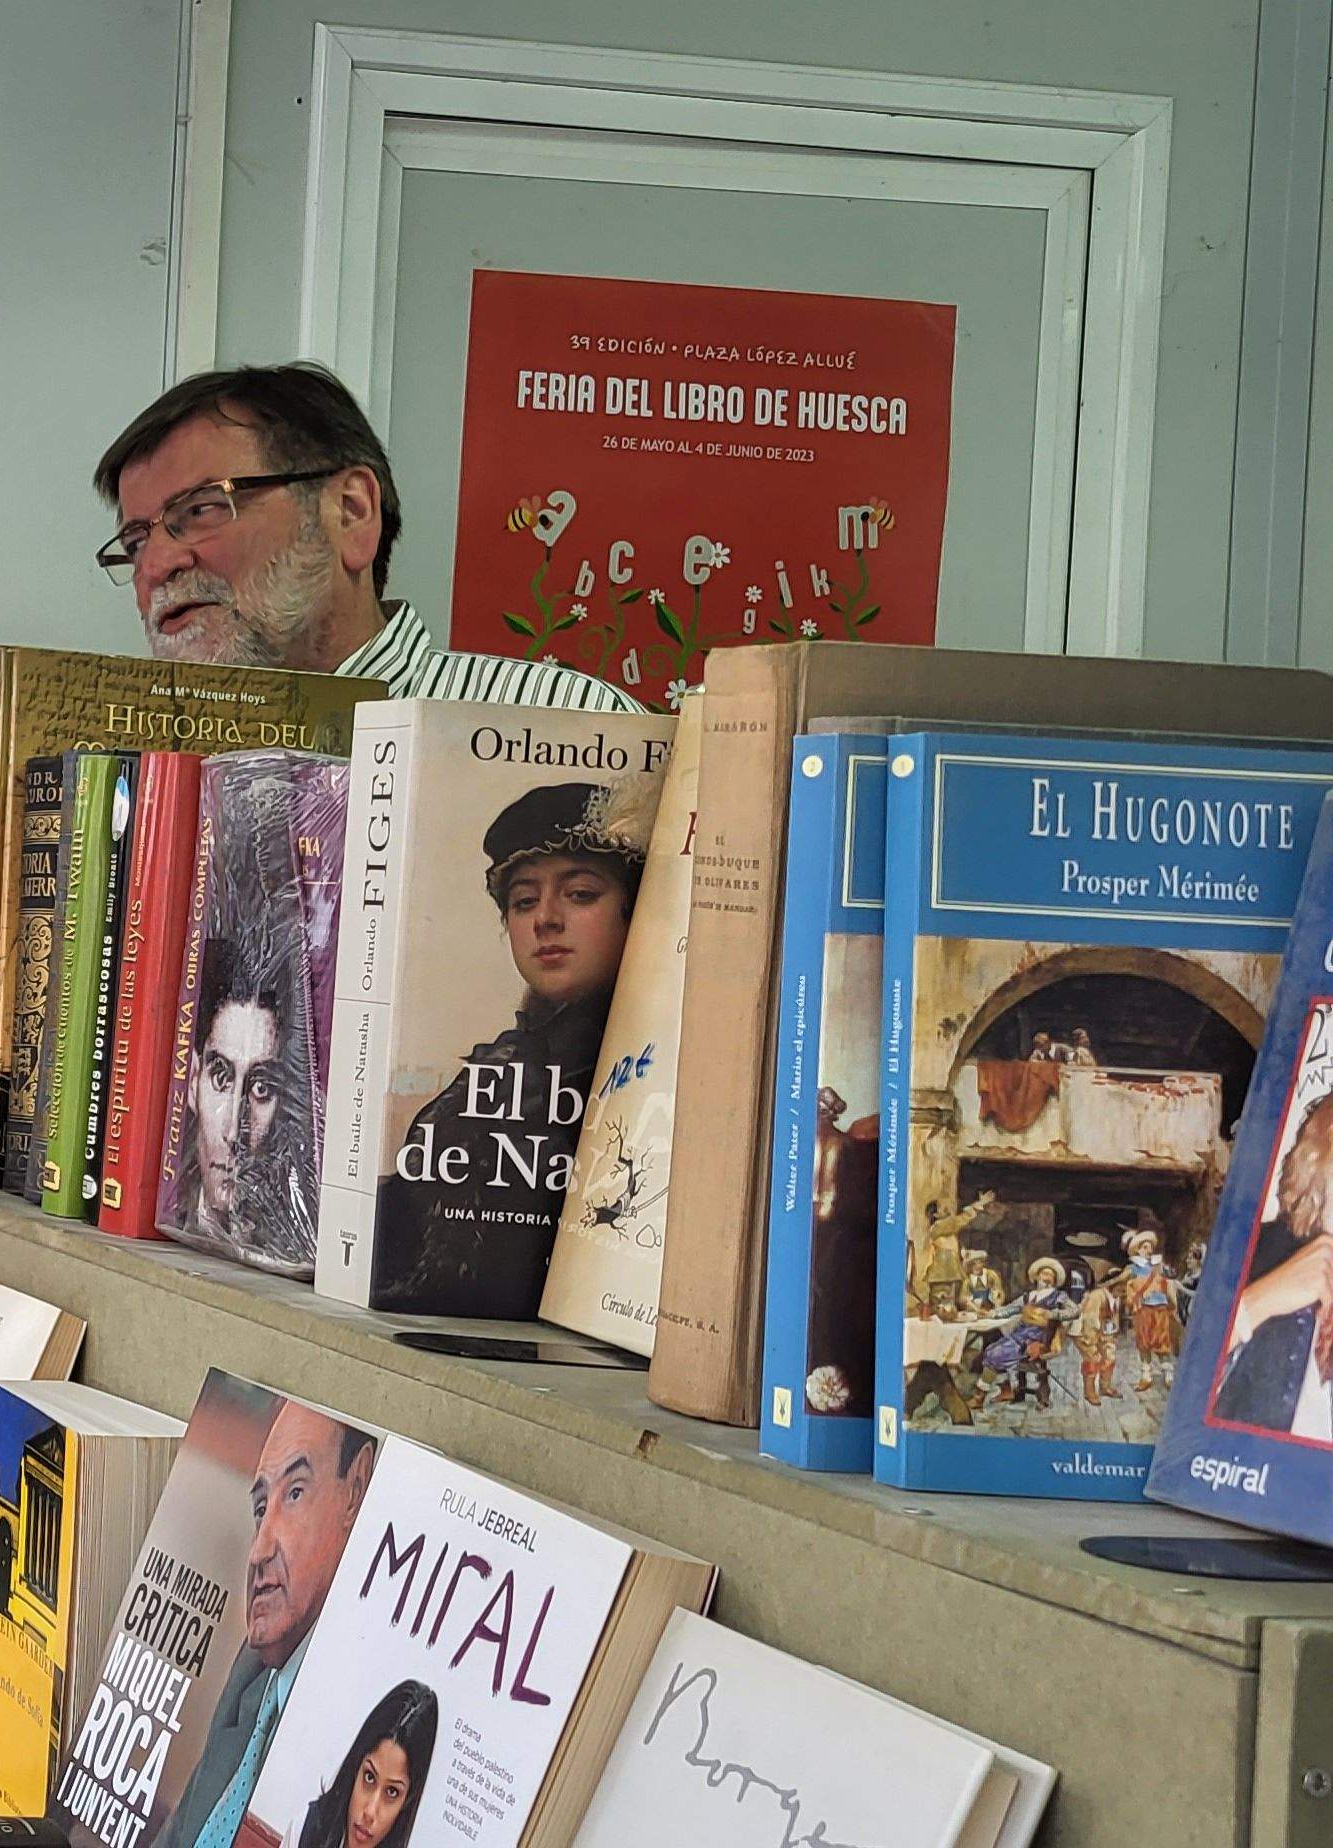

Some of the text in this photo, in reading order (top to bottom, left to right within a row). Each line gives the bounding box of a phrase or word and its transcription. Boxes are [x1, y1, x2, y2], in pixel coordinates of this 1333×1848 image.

[570, 335, 857, 370] 39 EDICIÓN PLAZA LÓPEZ ALLUÉ
[517, 369, 908, 436] FERIA DEL LIBRO DE HUESCA
[602, 435, 815, 462] 26 DE MAYO AL 4 DE JUNIO DE 2023
[150, 683, 172, 698] Ana
[193, 686, 237, 704] Vázquez
[240, 691, 267, 706] Hoys
[468, 725, 630, 773] Orlando
[1028, 774, 1297, 853] EL HUGONOTE
[67, 828, 84, 901] Twain
[1060, 860, 1261, 905] Prosper Mérimée
[348, 739, 398, 1179] El baile de Natasha Orlando FIGES
[163, 816, 214, 1182] Franz KAFKA OBRAS COMPLETAS
[84, 892, 117, 1160] Cumbres borrascosas Emily
[107, 899, 146, 1165] El de las leyes
[458, 1062, 525, 1121] El
[888, 1057, 900, 1074] El
[395, 1123, 470, 1185] de
[788, 1123, 800, 1162] Pater
[444, 1206, 552, 1226] UNA HISTORIA
[785, 1166, 799, 1214] Walter
[884, 1166, 898, 1226] Prosper
[601, 1291, 635, 1320] Círculo
[633, 1303, 645, 1324] de
[1049, 1454, 1147, 1480] valdemar
[1190, 1452, 1271, 1496] espiral
[438, 1487, 538, 1555] RULA JEBREAL
[141, 1545, 230, 1625] UNA MIRADA
[122, 1581, 215, 1678] CRÍTICA
[16, 1689, 28, 1709] de
[101, 1630, 192, 1734] MIQUEL
[71, 1682, 173, 1818] ROCA
[453, 1717, 483, 1743] El drama
[55, 1760, 75, 1801] I
[462, 1744, 486, 1767] pueblo
[484, 1759, 515, 1785] palestino
[62, 1772, 148, 1848] JUNYENT
